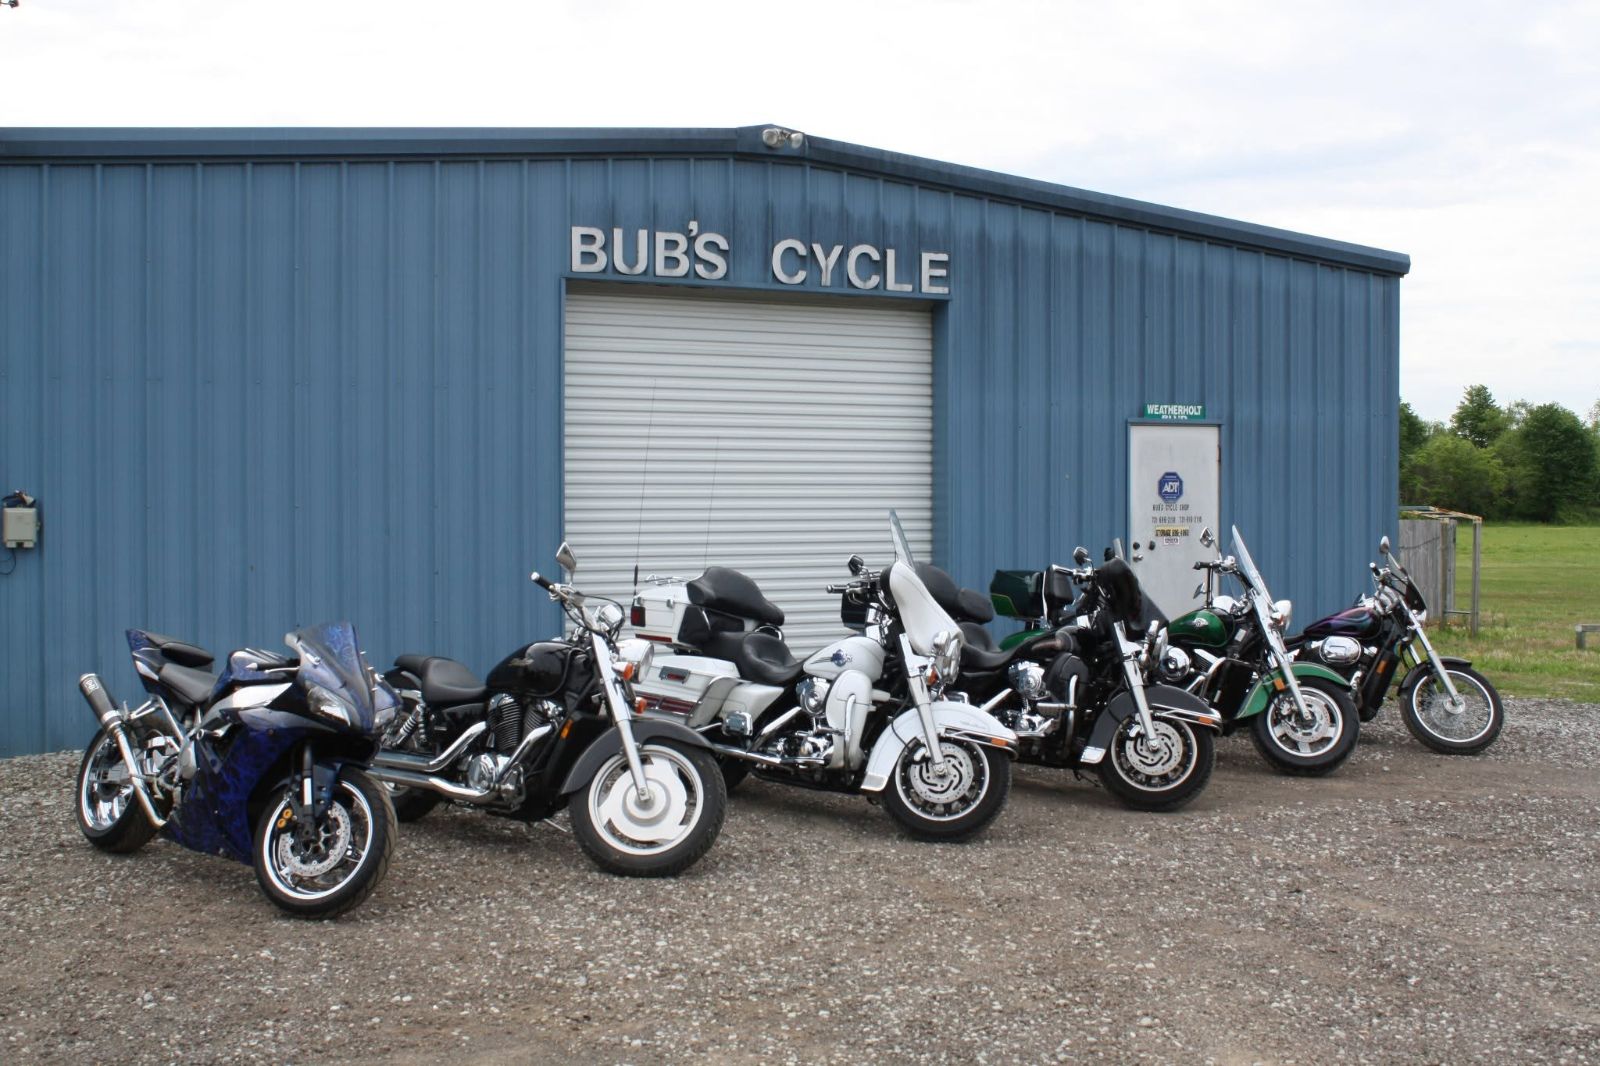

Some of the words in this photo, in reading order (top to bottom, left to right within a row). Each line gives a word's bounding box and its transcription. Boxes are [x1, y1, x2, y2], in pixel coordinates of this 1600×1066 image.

[571, 220, 730, 280] BUB'S
[772, 238, 950, 294] CYCLE
[1146, 404, 1203, 416] WEATHERHOLT
[1162, 481, 1180, 493] ADT
